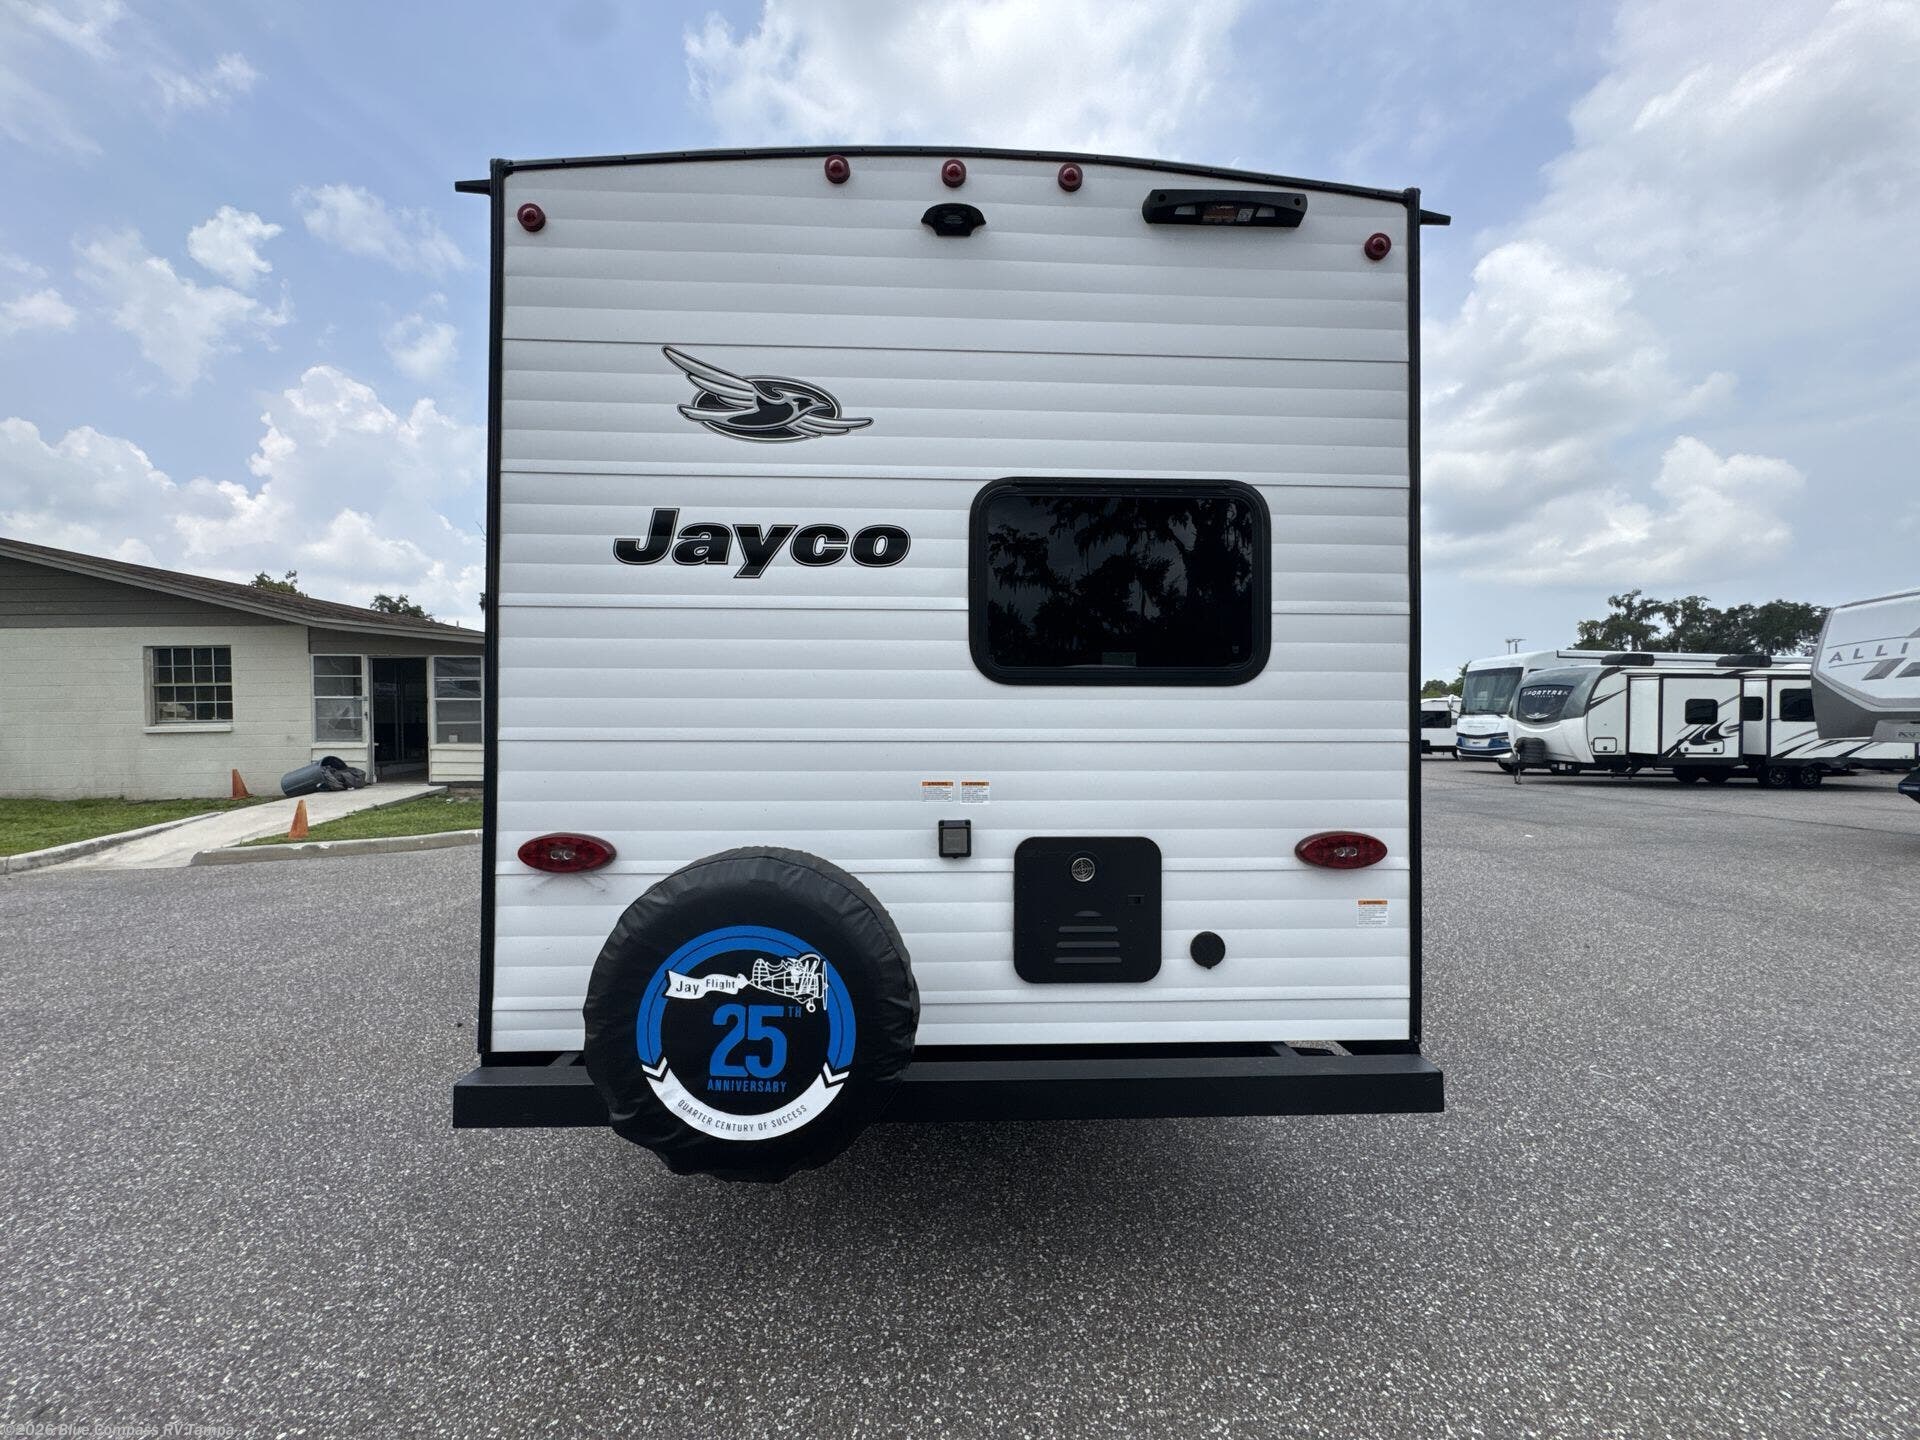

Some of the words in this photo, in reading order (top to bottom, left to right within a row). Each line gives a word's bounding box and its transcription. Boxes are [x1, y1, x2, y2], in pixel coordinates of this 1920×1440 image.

[613, 507, 912, 579] Jayco
[676, 981, 700, 995] Jay
[705, 978, 736, 990] Flight
[709, 1003, 788, 1079] 25
[787, 1006, 802, 1018] TH
[707, 1079, 788, 1093] ANNIVERSARY
[677, 1099, 713, 1125] QUARTER
[714, 1119, 755, 1132] CENTURY
[757, 1122, 769, 1131] OF
[771, 1104, 808, 1128] SUCCESS
